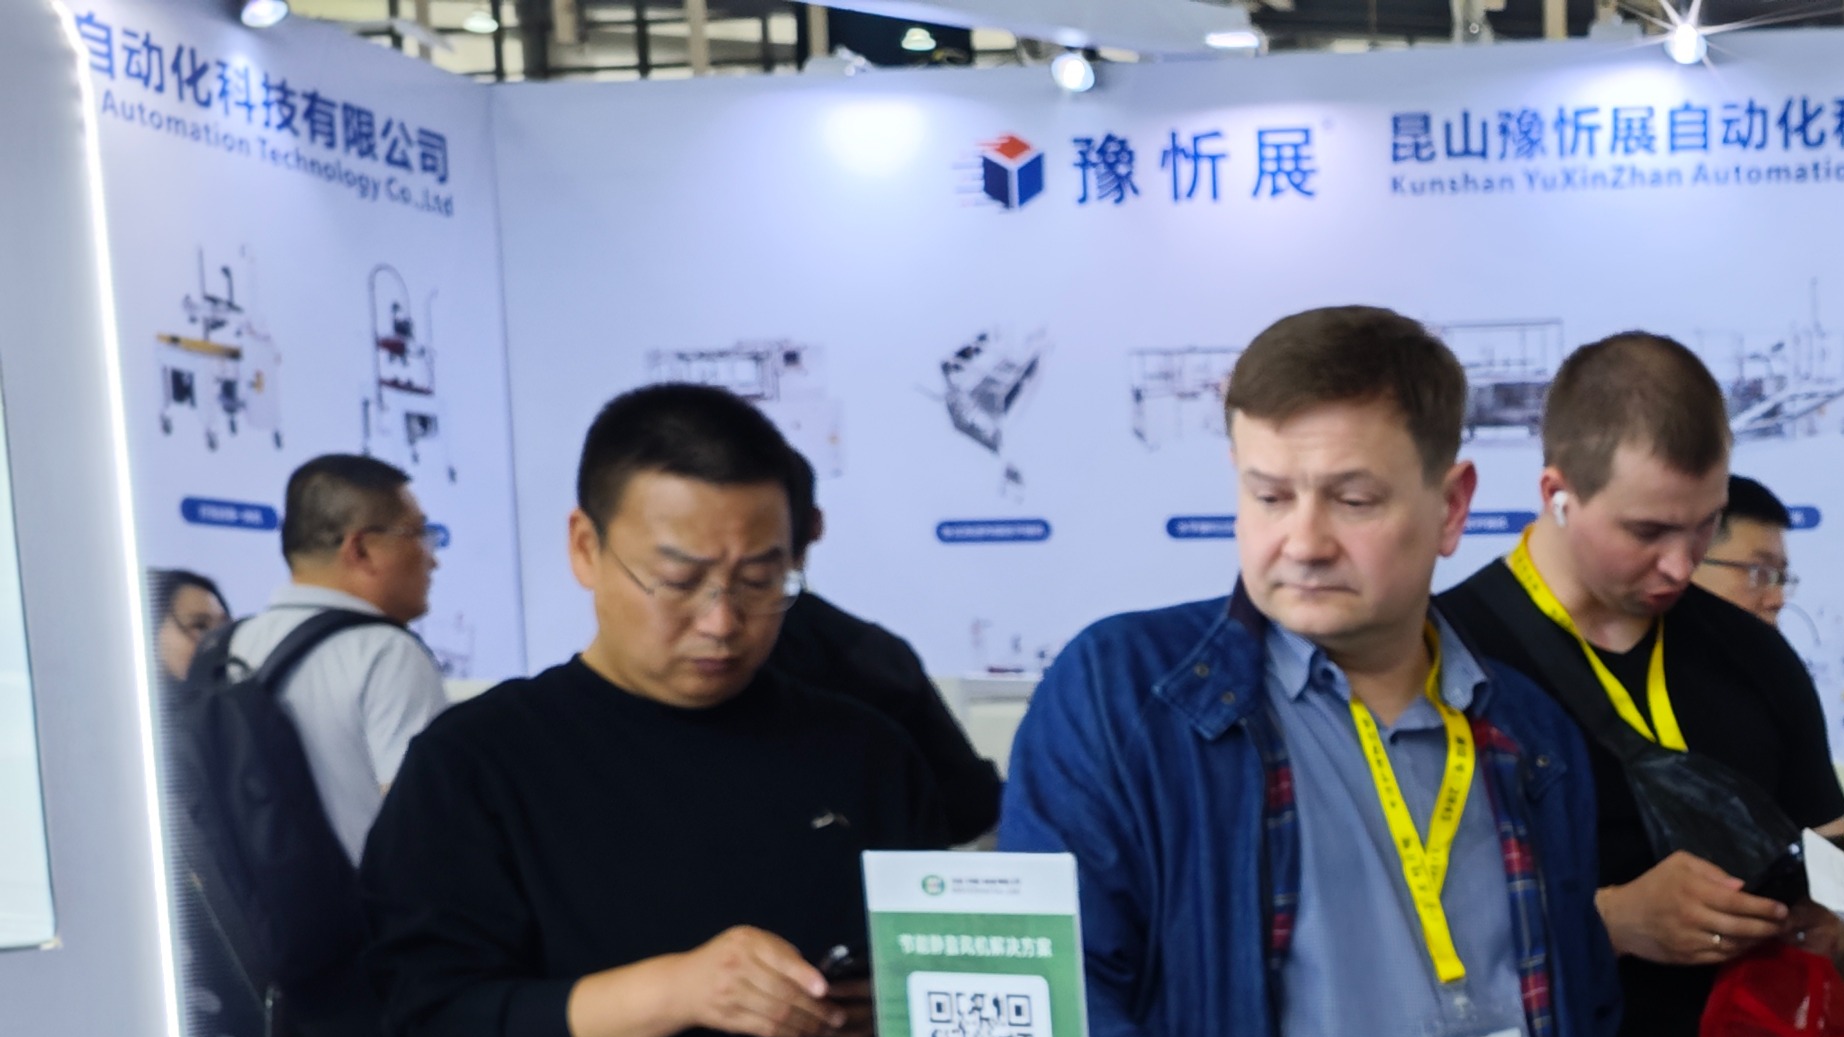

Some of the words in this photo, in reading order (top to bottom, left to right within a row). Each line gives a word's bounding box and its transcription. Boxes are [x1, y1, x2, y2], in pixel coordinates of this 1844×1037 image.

[76, 12, 450, 185] 自动化科技有限公司
[101, 89, 250, 156] Automation
[258, 138, 381, 201] Technology
[1071, 128, 1317, 204] 豫忻展
[1391, 172, 1515, 197] Kunshan
[1526, 165, 1685, 193] YuXinZhan
